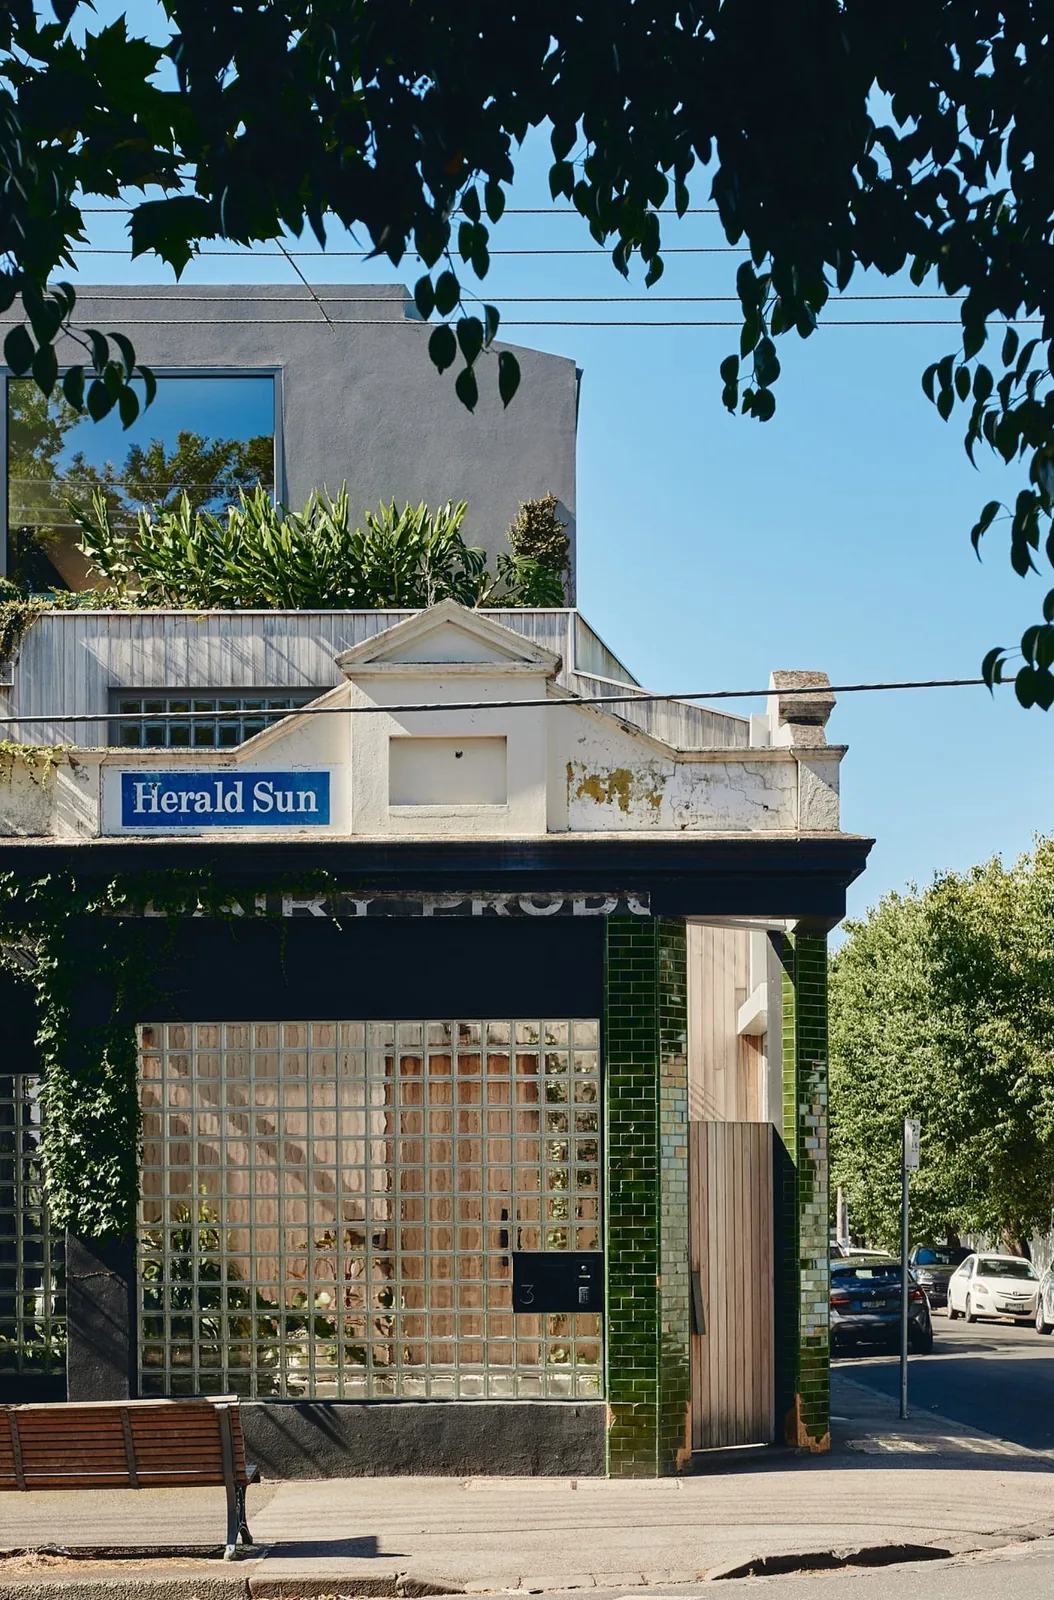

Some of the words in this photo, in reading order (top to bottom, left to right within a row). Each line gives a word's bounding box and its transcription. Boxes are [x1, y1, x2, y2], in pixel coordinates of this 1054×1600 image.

[133, 781, 245, 813] Herald
[252, 781, 318, 813] Sun
[422, 892, 651, 917] PROD
[519, 1284, 534, 1304] 3
